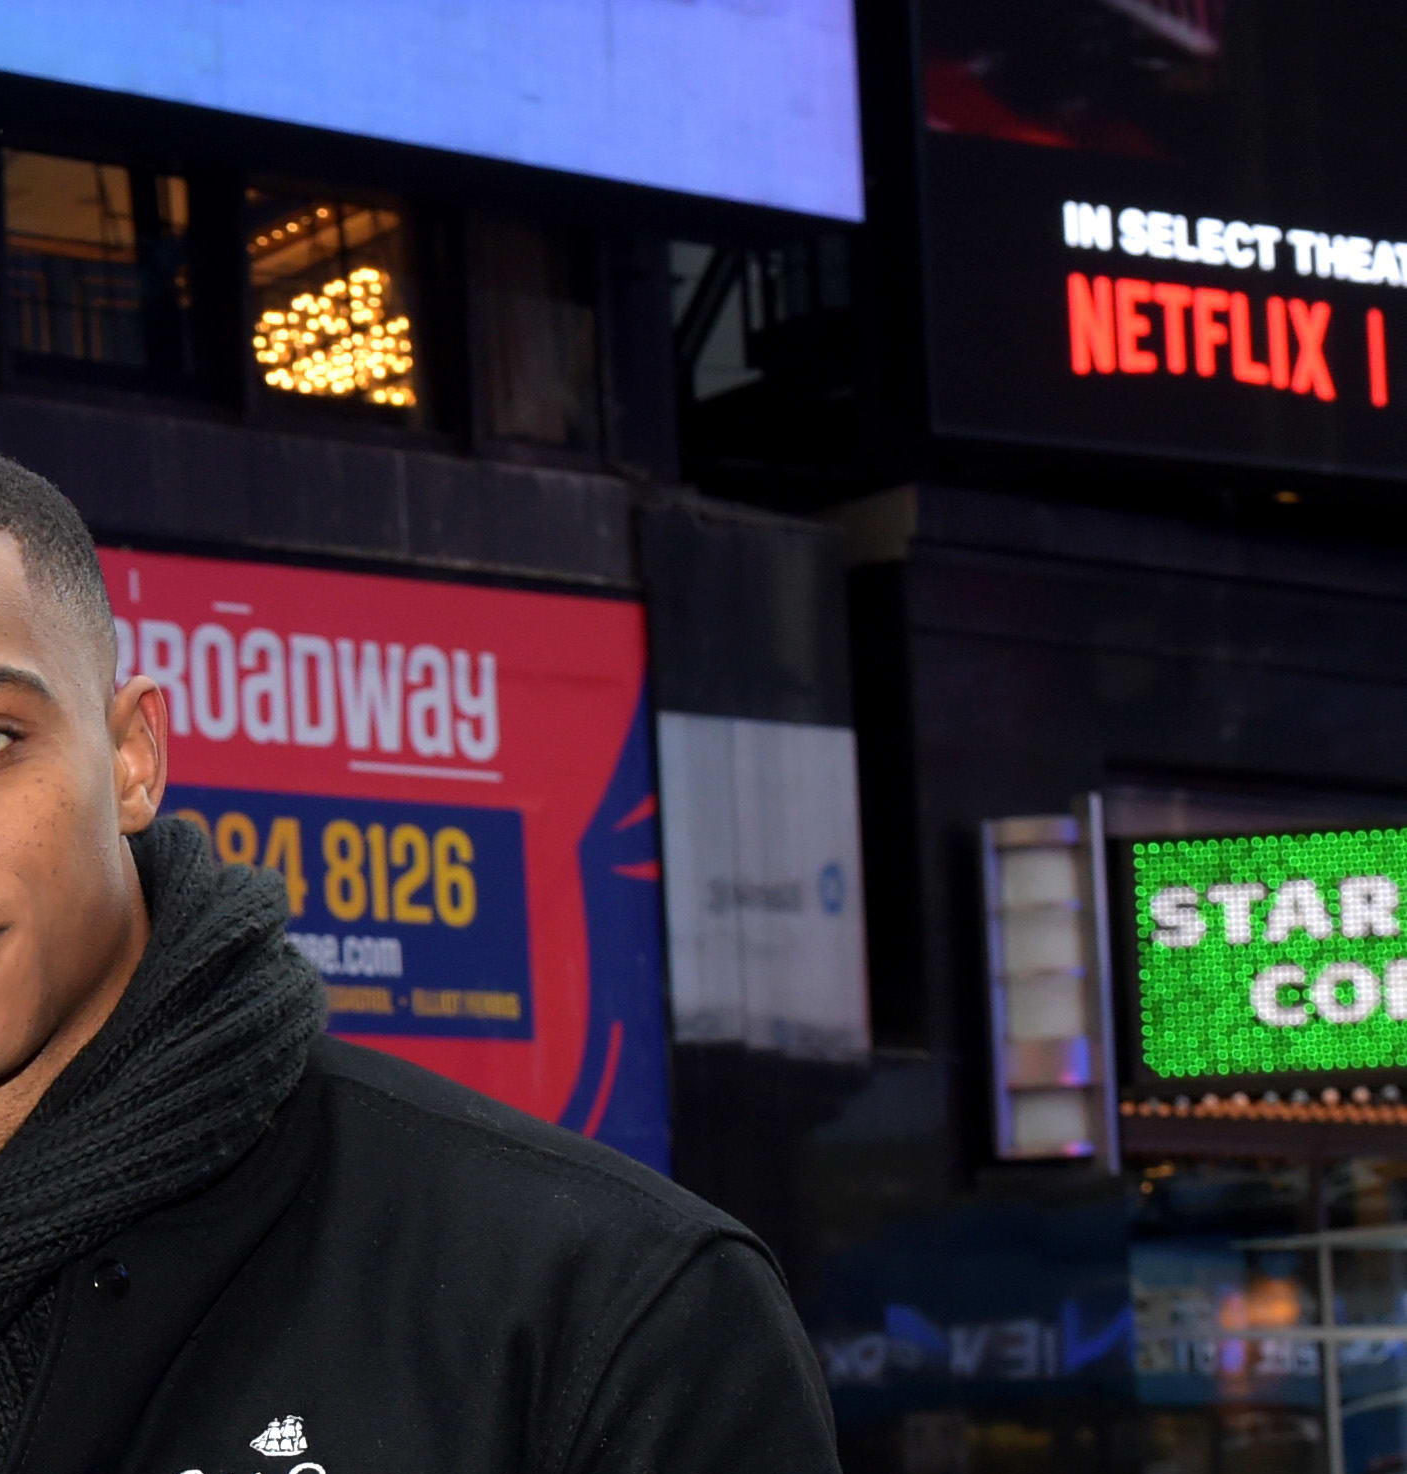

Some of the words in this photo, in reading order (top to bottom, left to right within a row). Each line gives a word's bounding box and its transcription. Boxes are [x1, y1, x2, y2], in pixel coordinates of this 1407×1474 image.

[1063, 200, 1113, 251] IN
[1118, 208, 1283, 272] SELECT
[1066, 271, 1336, 402] NETFLIX
[321, 818, 477, 928] 8126
[1150, 874, 1400, 948] STAR
